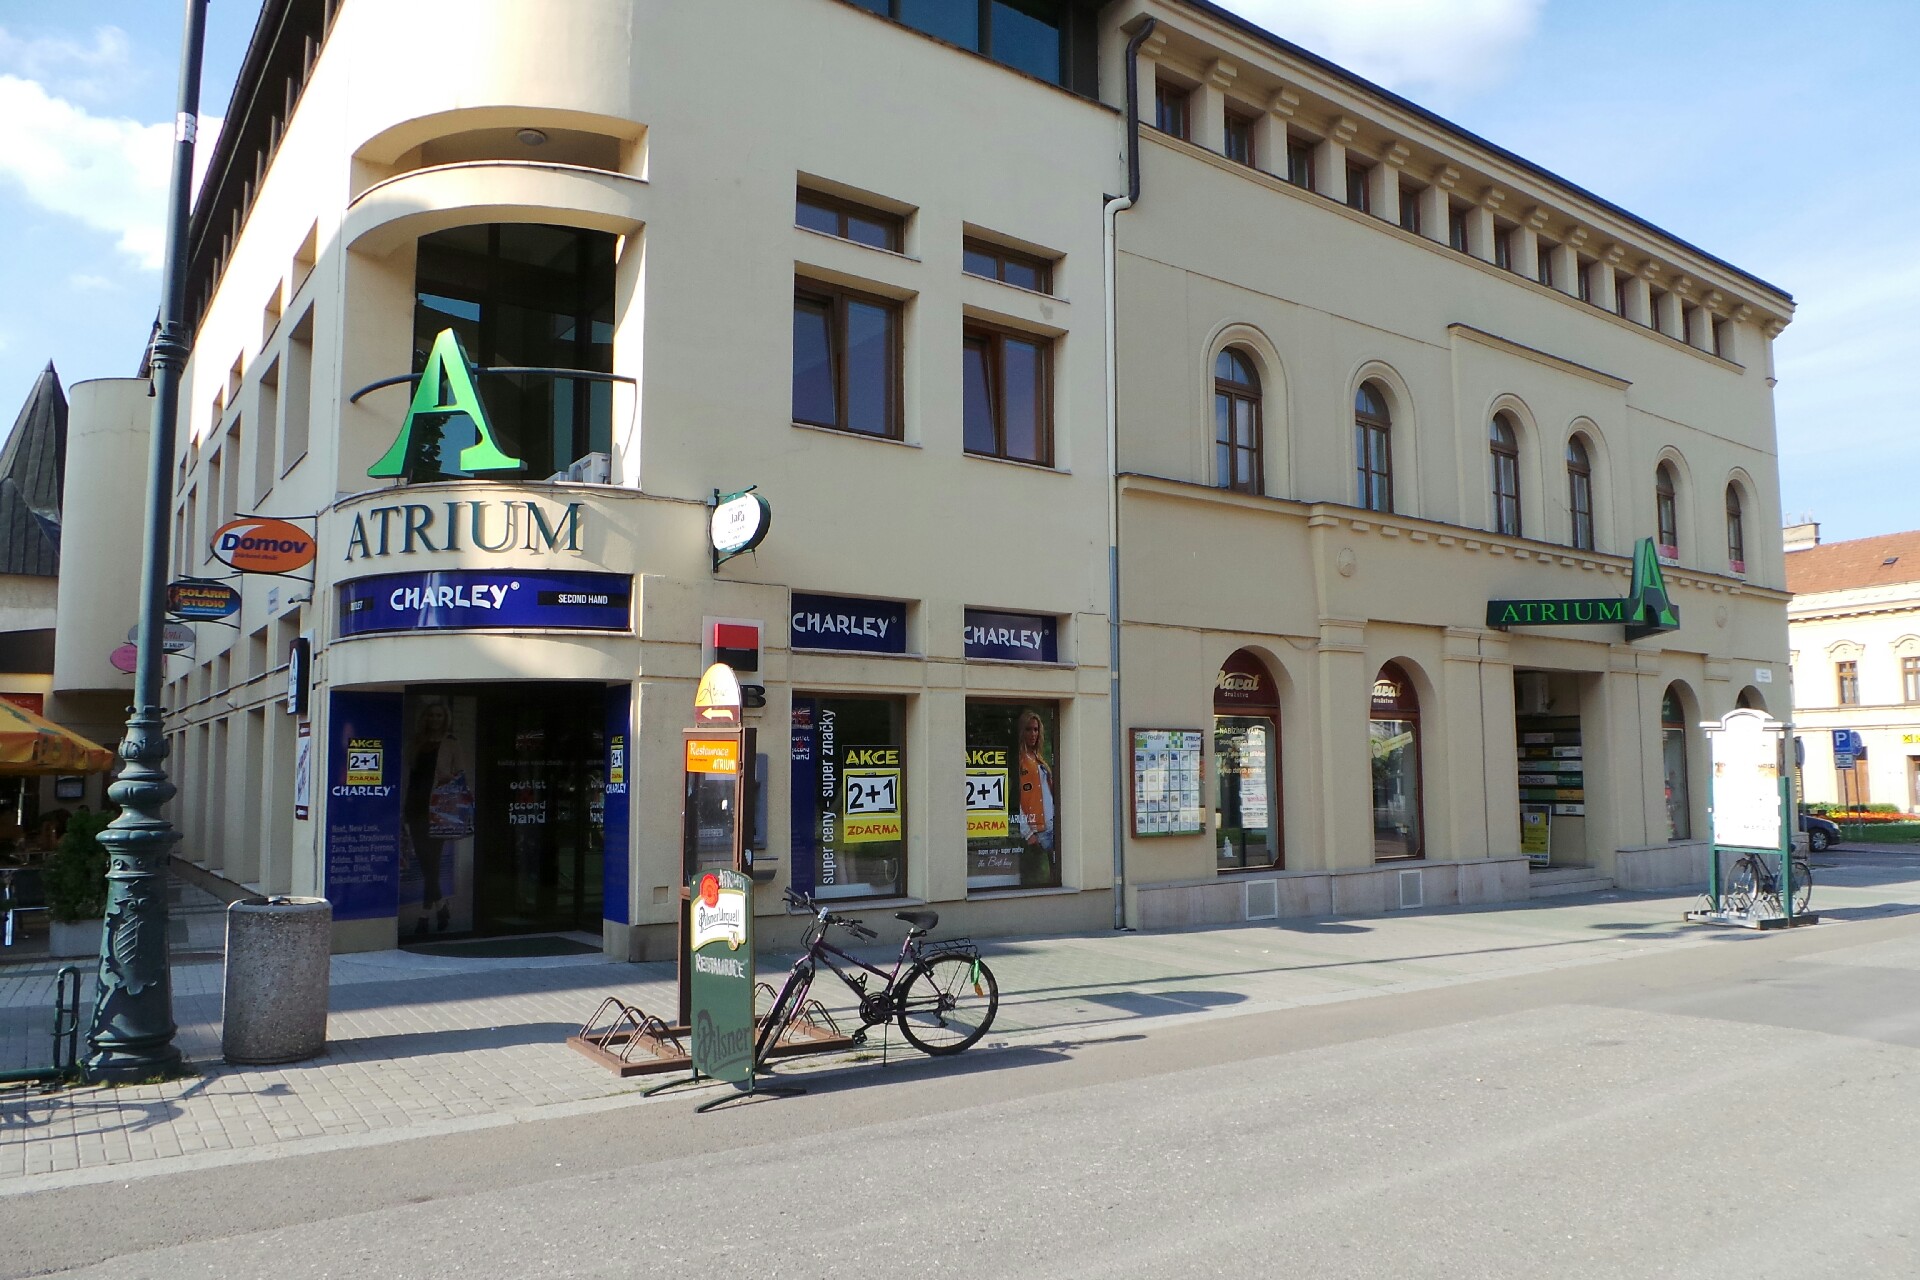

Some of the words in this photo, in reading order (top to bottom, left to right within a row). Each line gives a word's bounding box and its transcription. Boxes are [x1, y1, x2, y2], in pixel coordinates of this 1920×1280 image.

[345, 500, 585, 562] ATRIUM
[220, 533, 308, 554] Domov
[182, 599, 226, 608] STUDIO
[558, 594, 586, 604] SECOND
[588, 595, 608, 605] HAND
[1501, 601, 1625, 622] ATRIUM
[1372, 683, 1402, 697] arat
[818, 709, 837, 755] značky
[1835, 732, 1847, 746] P
[349, 740, 382, 748] AKCE
[690, 742, 729, 756] Restaurace
[350, 754, 380, 769] 2+1
[713, 758, 736, 770] ATRIUM
[792, 753, 810, 761] hand
[845, 750, 899, 766] AKCE
[509, 780, 547, 790] outlet
[822, 759, 837, 797] super
[848, 778, 895, 810] 2+1
[966, 777, 1003, 806] 2+1
[508, 801, 546, 811] second
[508, 811, 546, 824] hand
[822, 811, 837, 842] ceny
[847, 824, 899, 836] ZDARMA
[967, 820, 1006, 831] DARMA
[822, 847, 837, 884] super
[698, 906, 719, 933] Pilsner
[718, 907, 740, 928] Urquell
[697, 1008, 751, 1068] Pilsner
